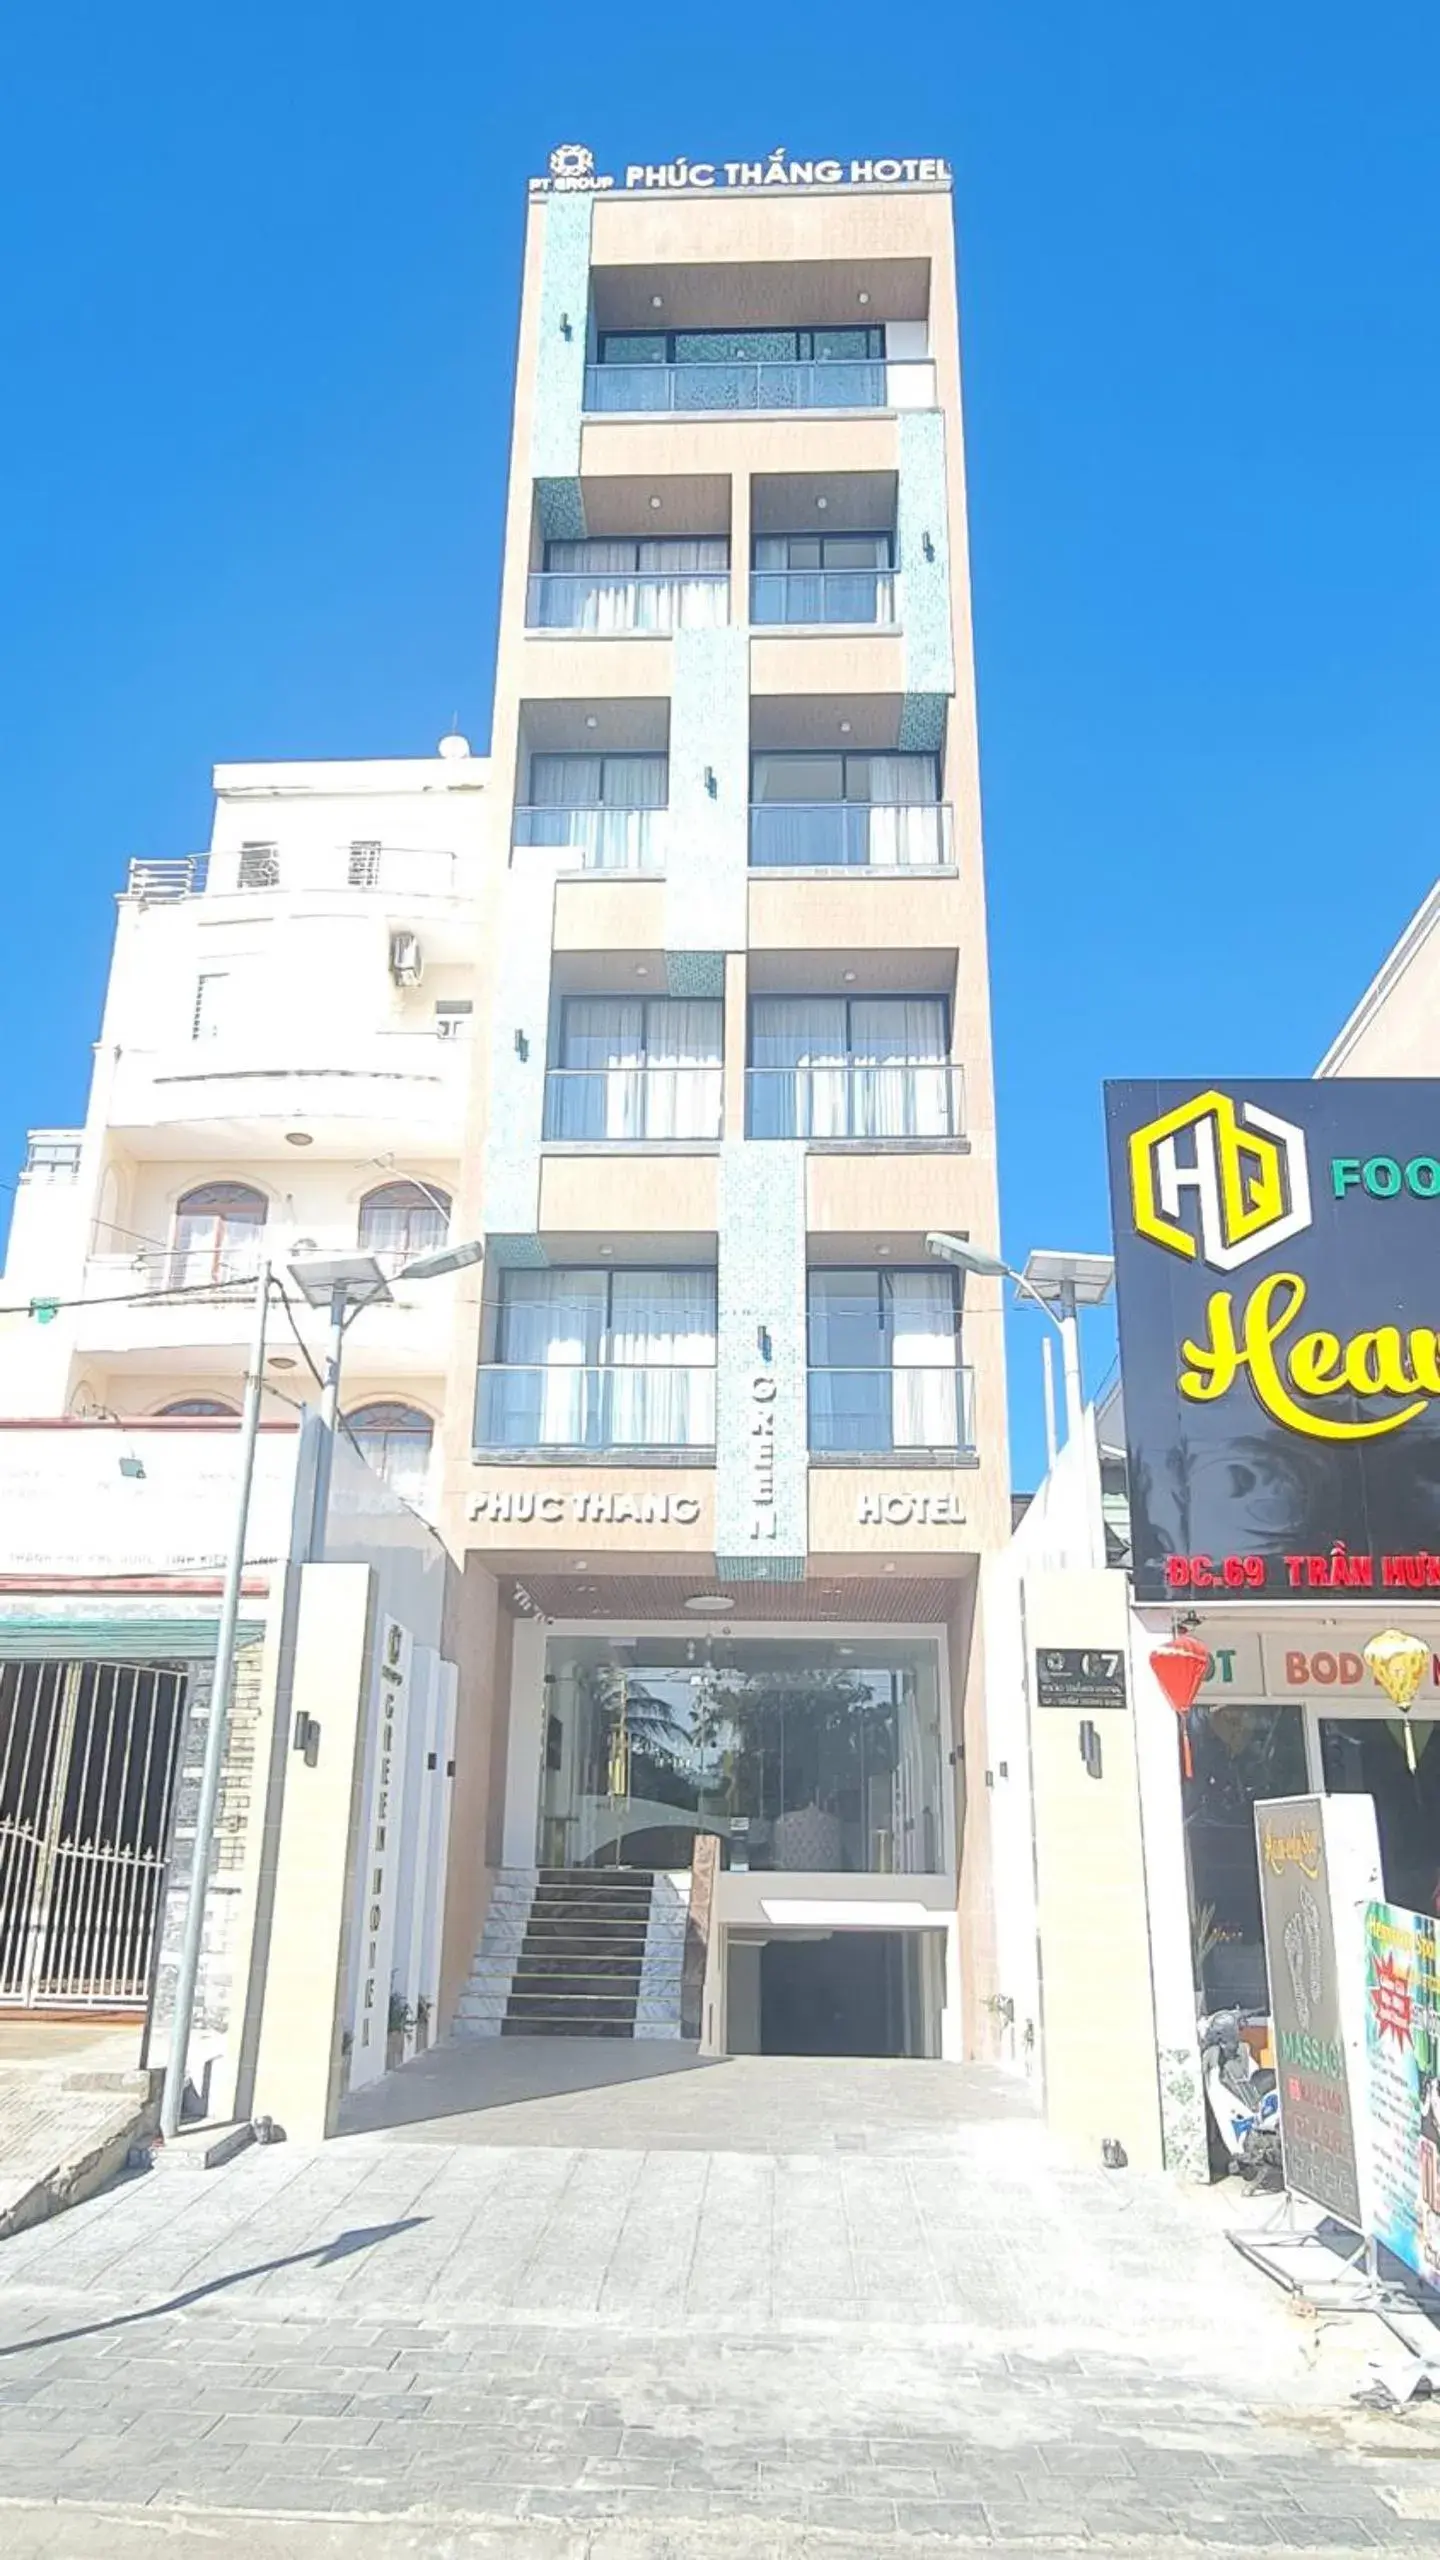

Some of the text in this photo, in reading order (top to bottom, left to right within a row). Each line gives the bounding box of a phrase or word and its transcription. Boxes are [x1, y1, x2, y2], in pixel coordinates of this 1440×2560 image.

[529, 176, 614, 192] PT GROUP
[625, 147, 952, 188] PHÚC THẮNG HOTEL
[857, 1492, 967, 1525] HOTEL
[1285, 1539, 1373, 1588] TRẦN
[1285, 1651, 1390, 1686] BOD
